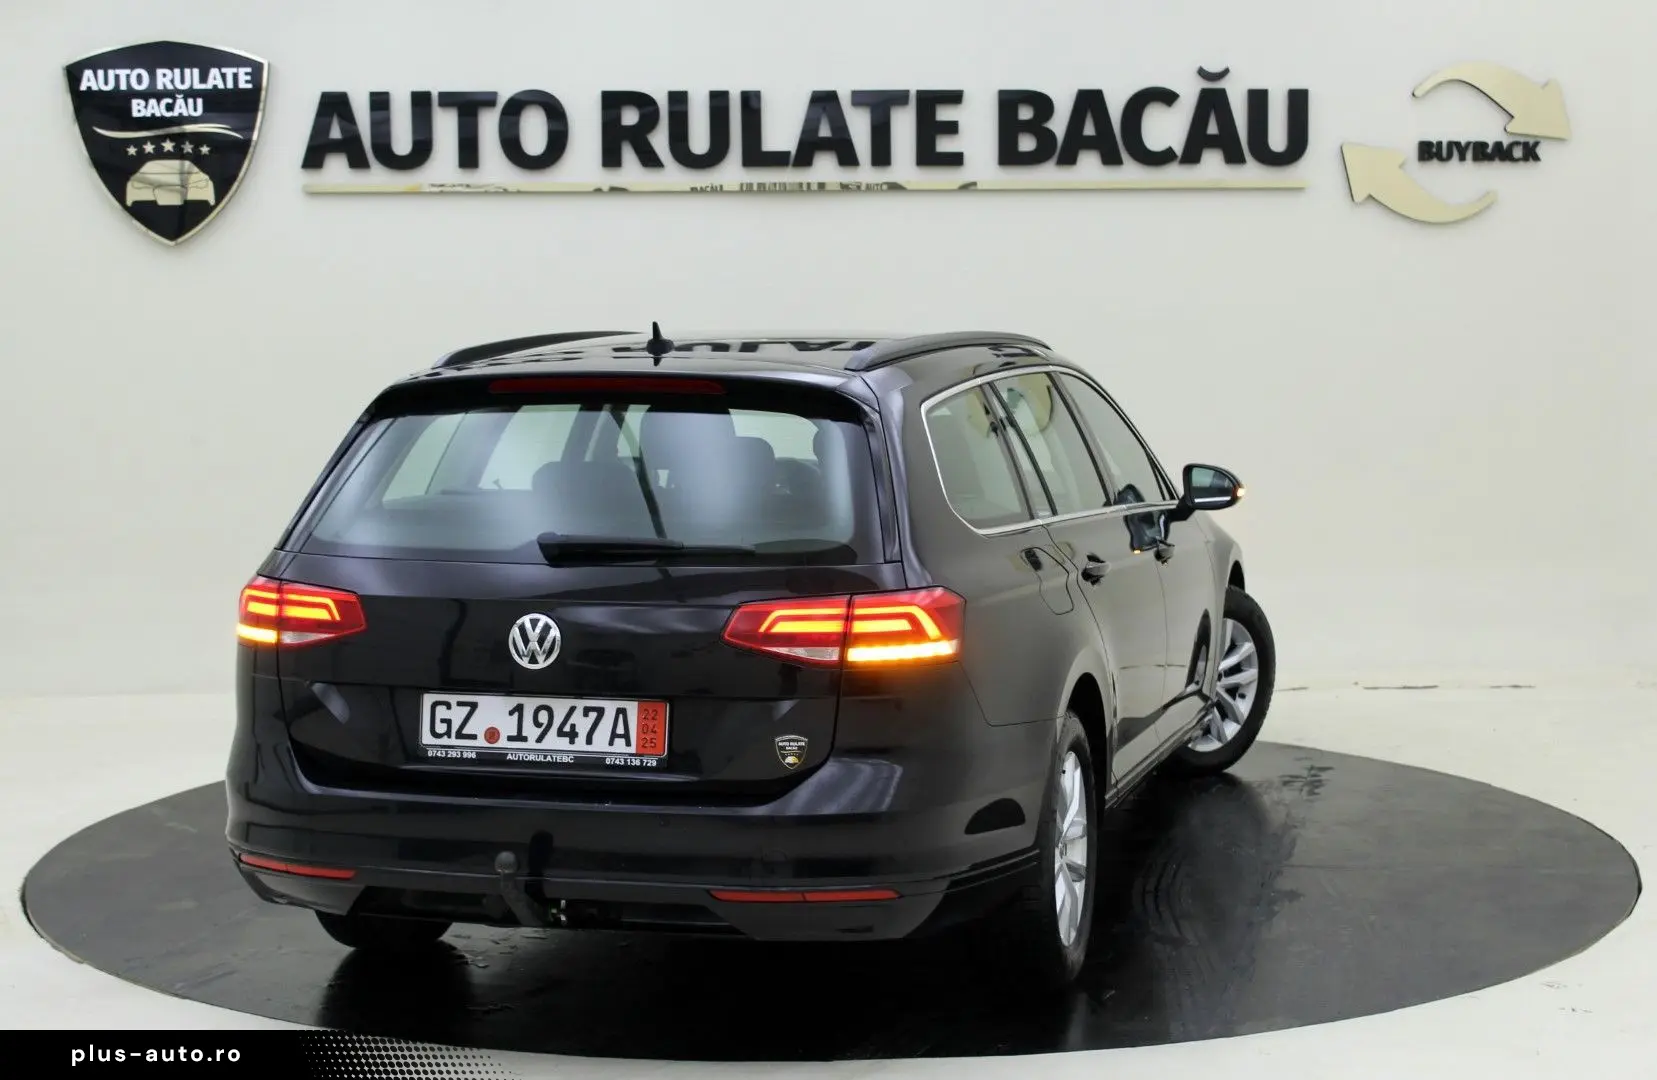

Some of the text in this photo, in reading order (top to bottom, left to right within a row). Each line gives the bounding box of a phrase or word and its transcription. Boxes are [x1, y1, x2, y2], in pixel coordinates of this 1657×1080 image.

[79, 67, 253, 91] AUTO RULATE
[131, 94, 203, 118] BACĂU
[301, 65, 1309, 170] AUTO RULATE BACĂU
[1417, 140, 1541, 162] BUYBACK
[642, 708, 658, 720] 22
[429, 700, 632, 747] GZ 1947A
[641, 723, 658, 734] 04
[641, 737, 657, 748] 25
[427, 749, 477, 759] 0743 293 996
[506, 752, 575, 763] AUTORULATEBC
[605, 757, 657, 767] 0743 136 729
